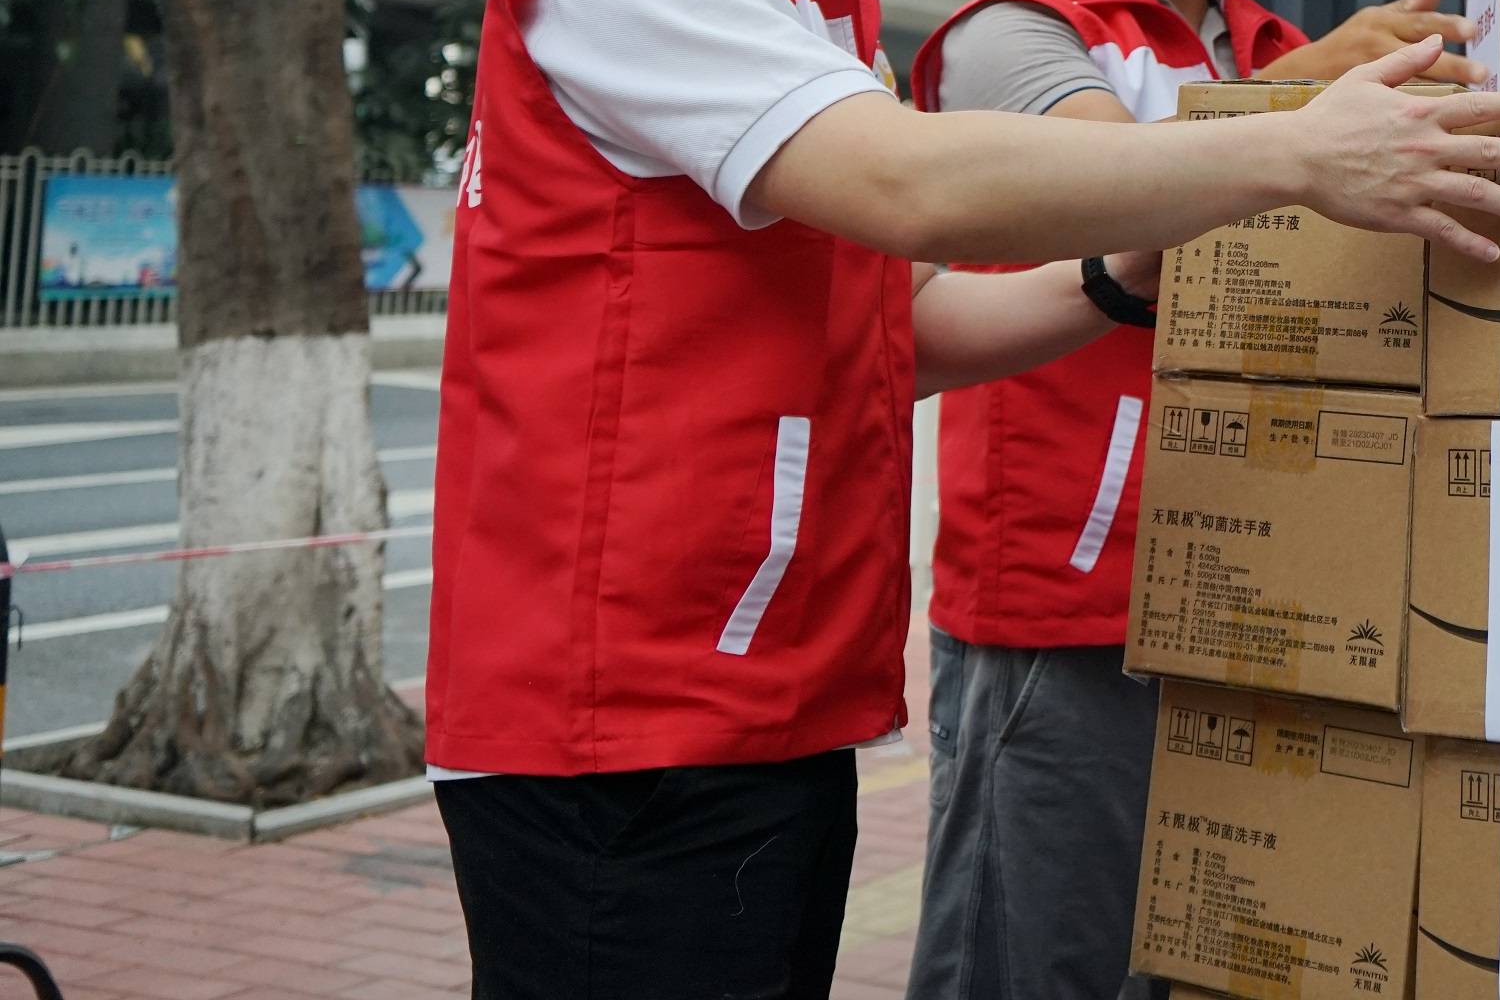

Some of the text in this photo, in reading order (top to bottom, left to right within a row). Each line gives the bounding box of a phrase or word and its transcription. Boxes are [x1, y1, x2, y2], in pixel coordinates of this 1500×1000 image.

[1378, 327, 1418, 337] INFINITUS
[1383, 336, 1412, 349] 无限极
[1345, 644, 1385, 657] INFINITUS
[1349, 655, 1378, 669] 无限极
[1349, 967, 1389, 982] INFINITUS
[1353, 978, 1382, 994] 无限极
